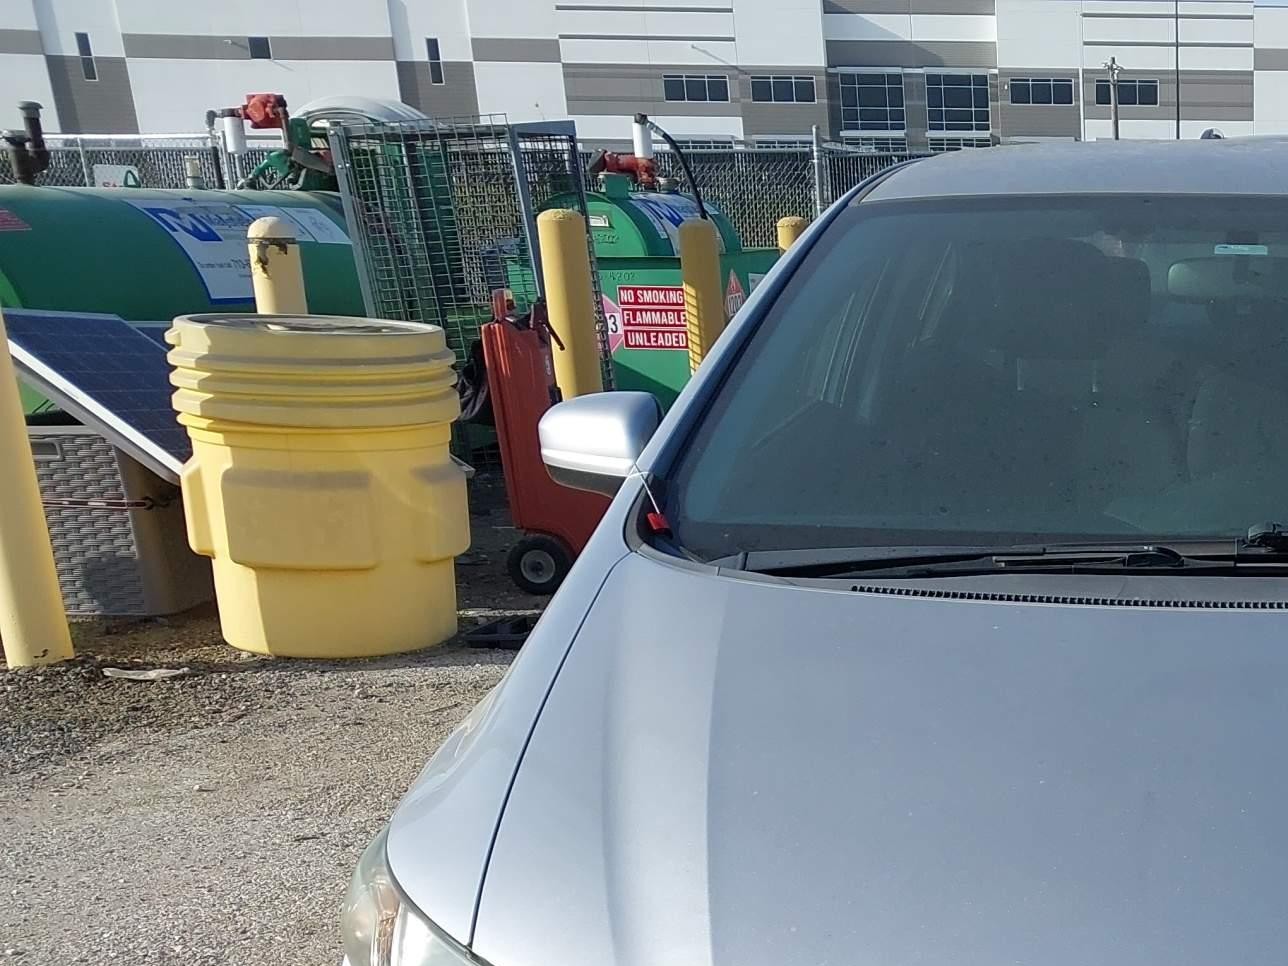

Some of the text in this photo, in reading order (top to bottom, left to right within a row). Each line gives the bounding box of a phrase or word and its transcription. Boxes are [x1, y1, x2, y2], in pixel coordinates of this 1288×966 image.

[620, 290, 684, 304] NO SMOKING
[624, 311, 687, 325] FLAMMABLE
[628, 332, 686, 347] UNLEADED
